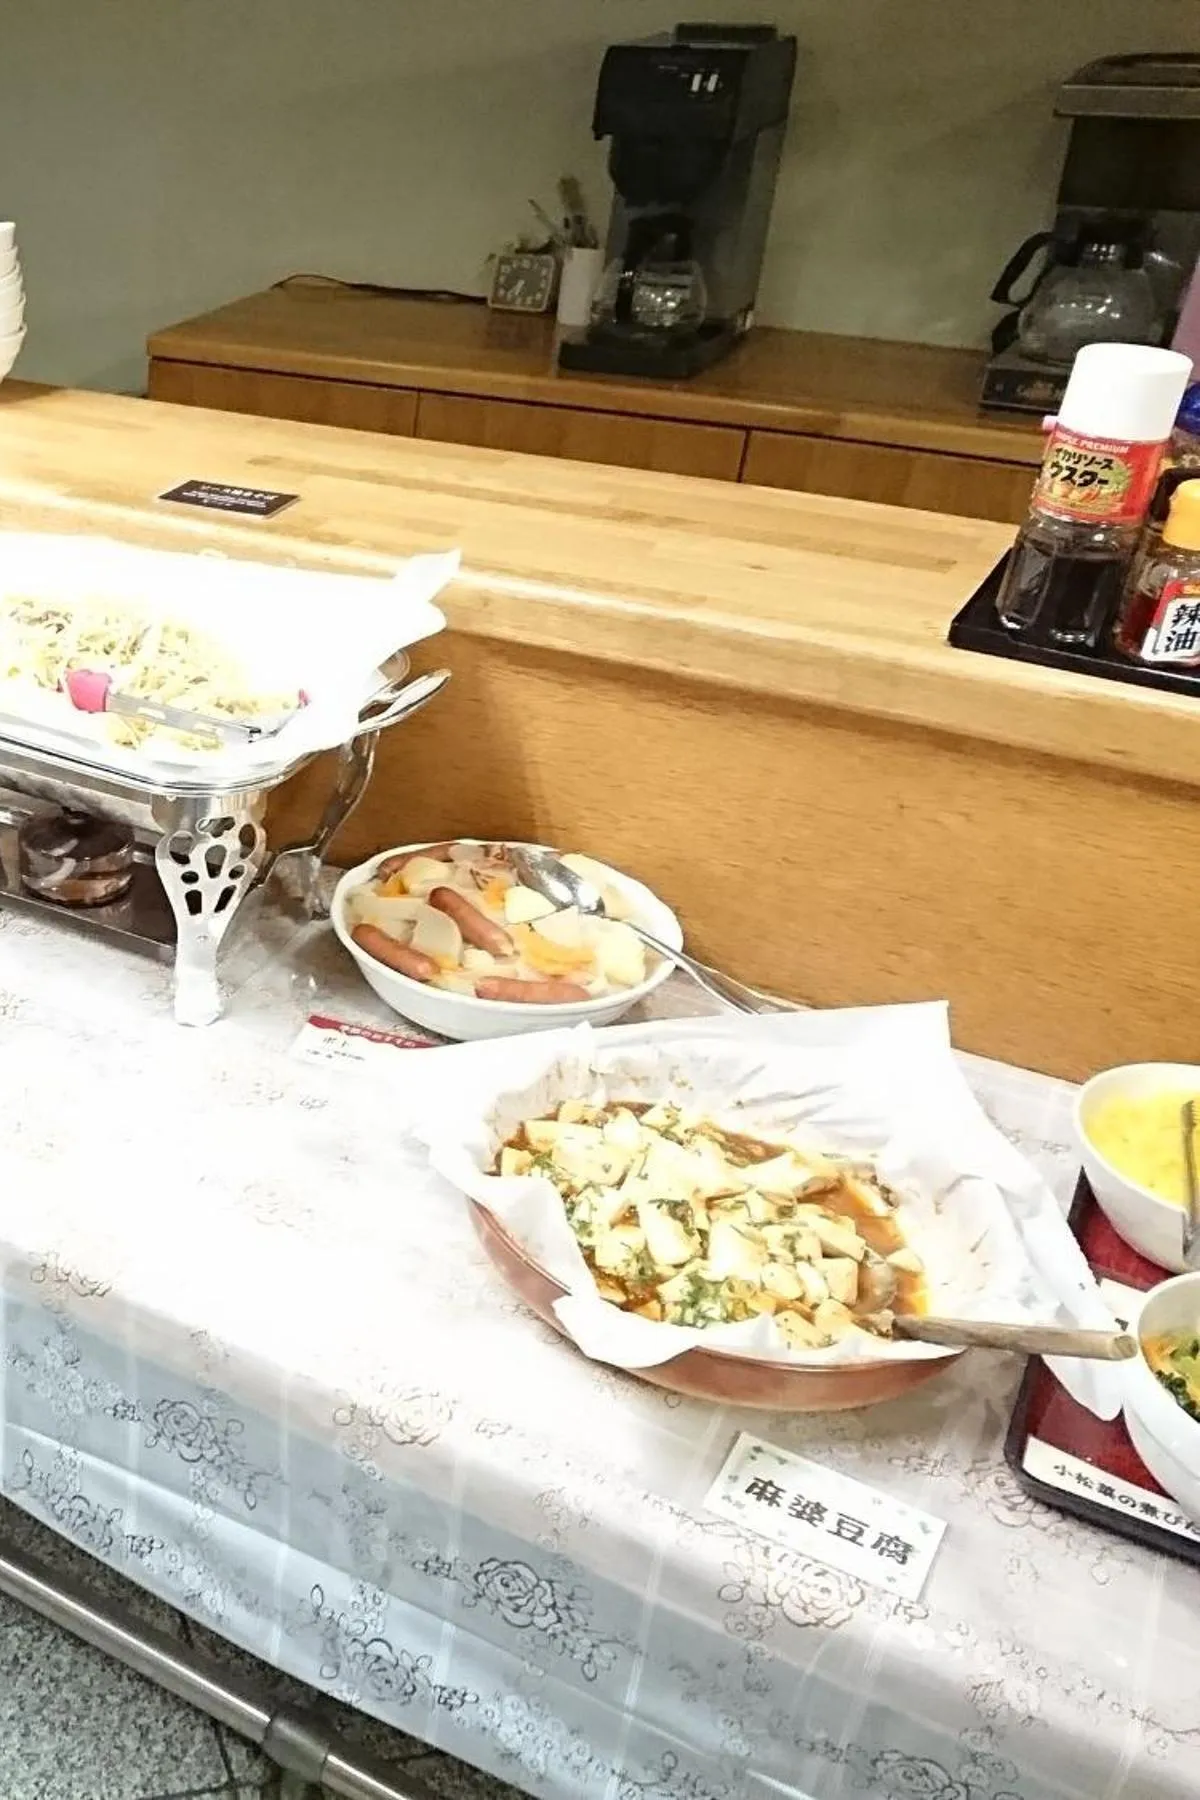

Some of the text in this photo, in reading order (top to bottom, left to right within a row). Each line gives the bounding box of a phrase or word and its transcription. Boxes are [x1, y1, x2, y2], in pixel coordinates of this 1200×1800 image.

[1055, 447, 1115, 470] イカリソース
[1050, 461, 1110, 487] ウスター
[745, 1477, 915, 1565] 麻婆豆腐
